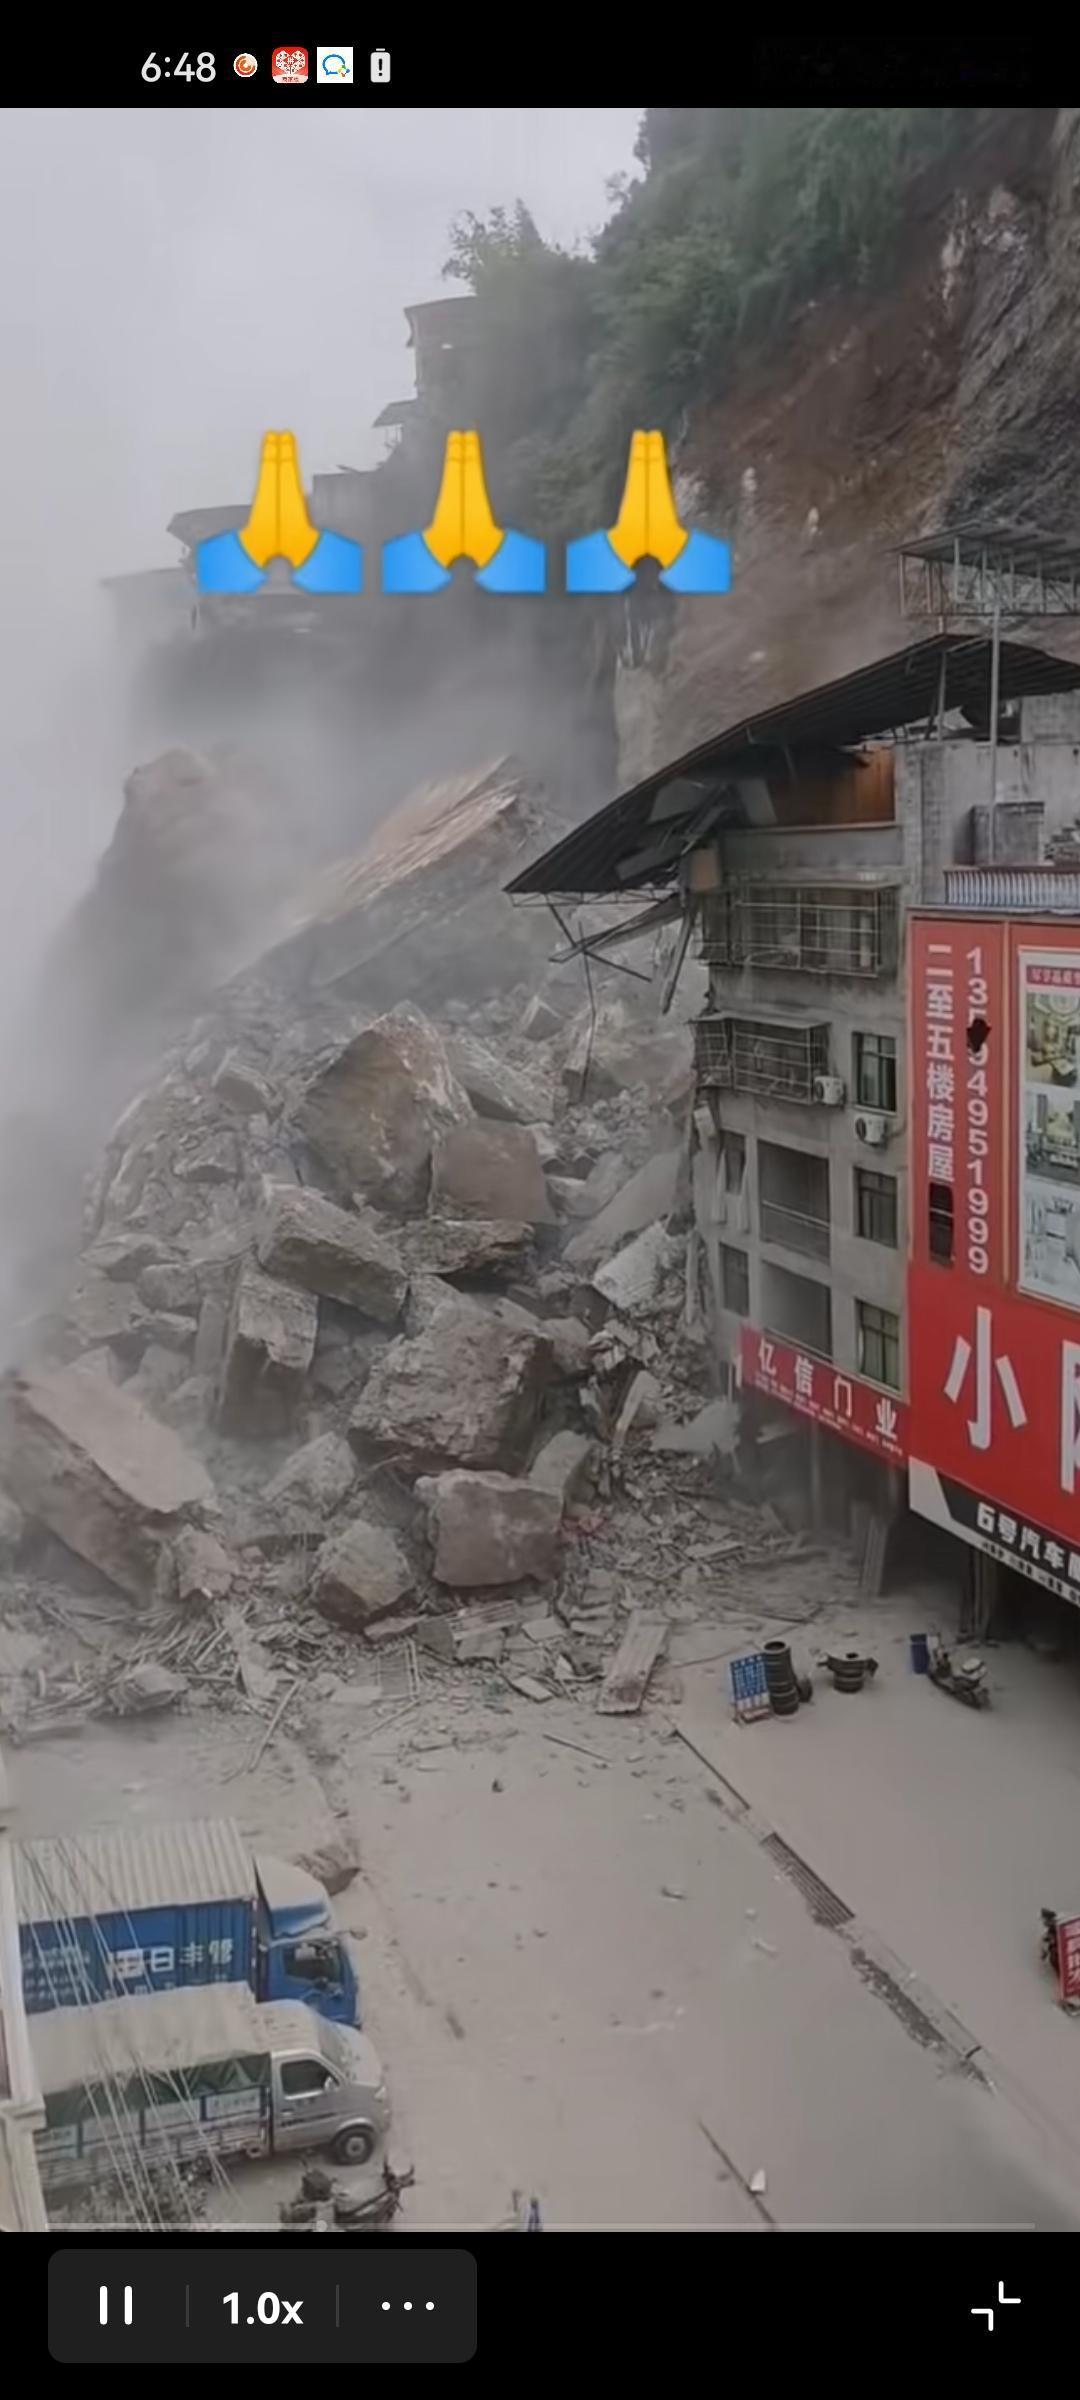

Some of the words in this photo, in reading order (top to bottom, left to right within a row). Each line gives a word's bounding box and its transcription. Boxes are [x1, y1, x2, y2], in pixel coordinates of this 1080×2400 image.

[141, 51, 216, 83] 6:48
[925, 943, 953, 1183] 二至五楼房屋
[758, 1336, 898, 1442] 亿信门业
[222, 2292, 304, 2325] 1.0x
